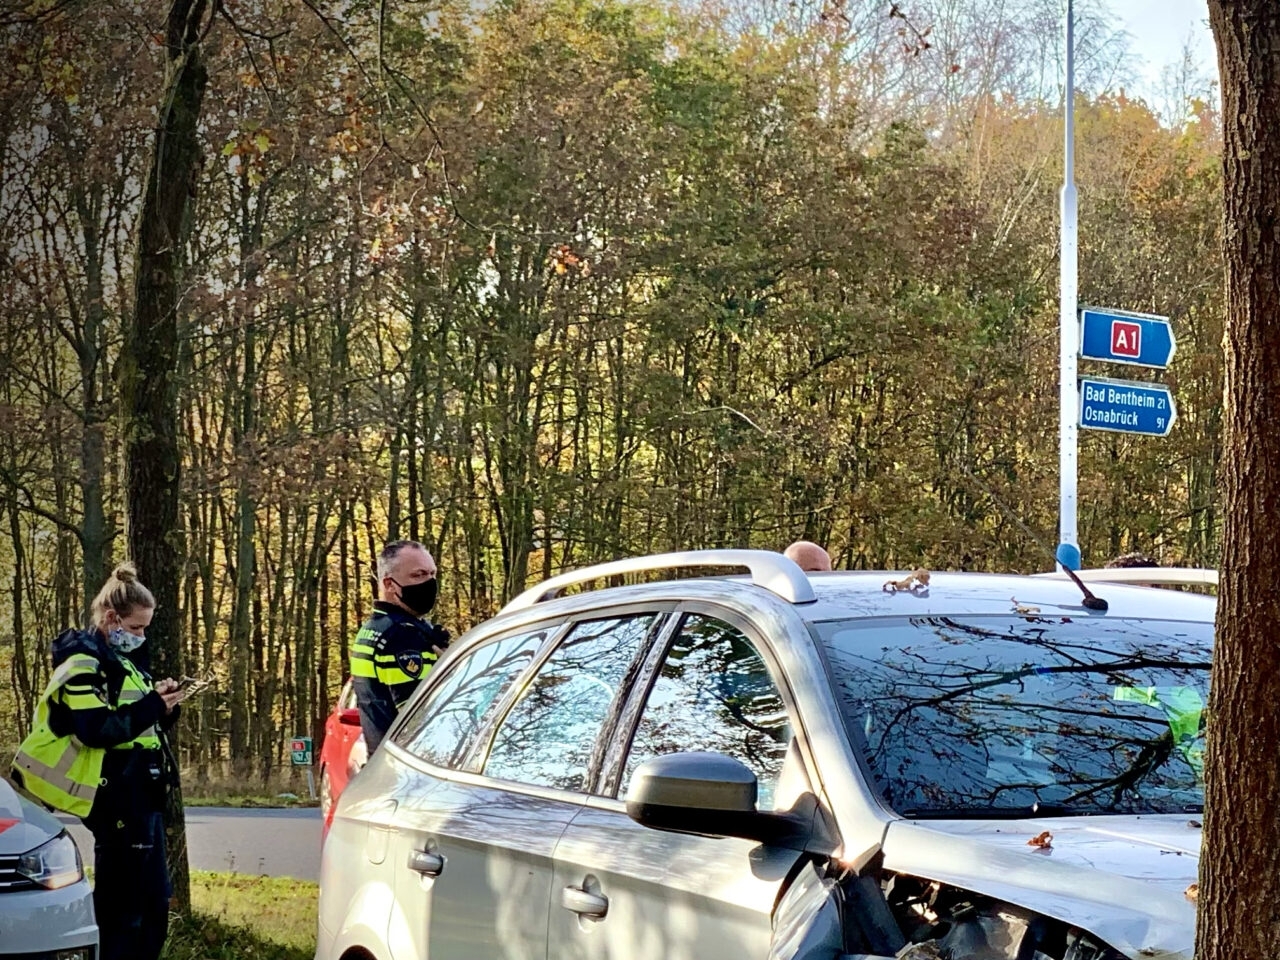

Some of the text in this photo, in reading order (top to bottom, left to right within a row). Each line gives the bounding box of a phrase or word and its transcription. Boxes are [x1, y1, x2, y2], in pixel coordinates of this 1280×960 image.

[1115, 329, 1136, 351] A1
[1086, 386, 1166, 410] Bad Bentheim 21
[1085, 405, 1165, 429] Osnabrück 91
